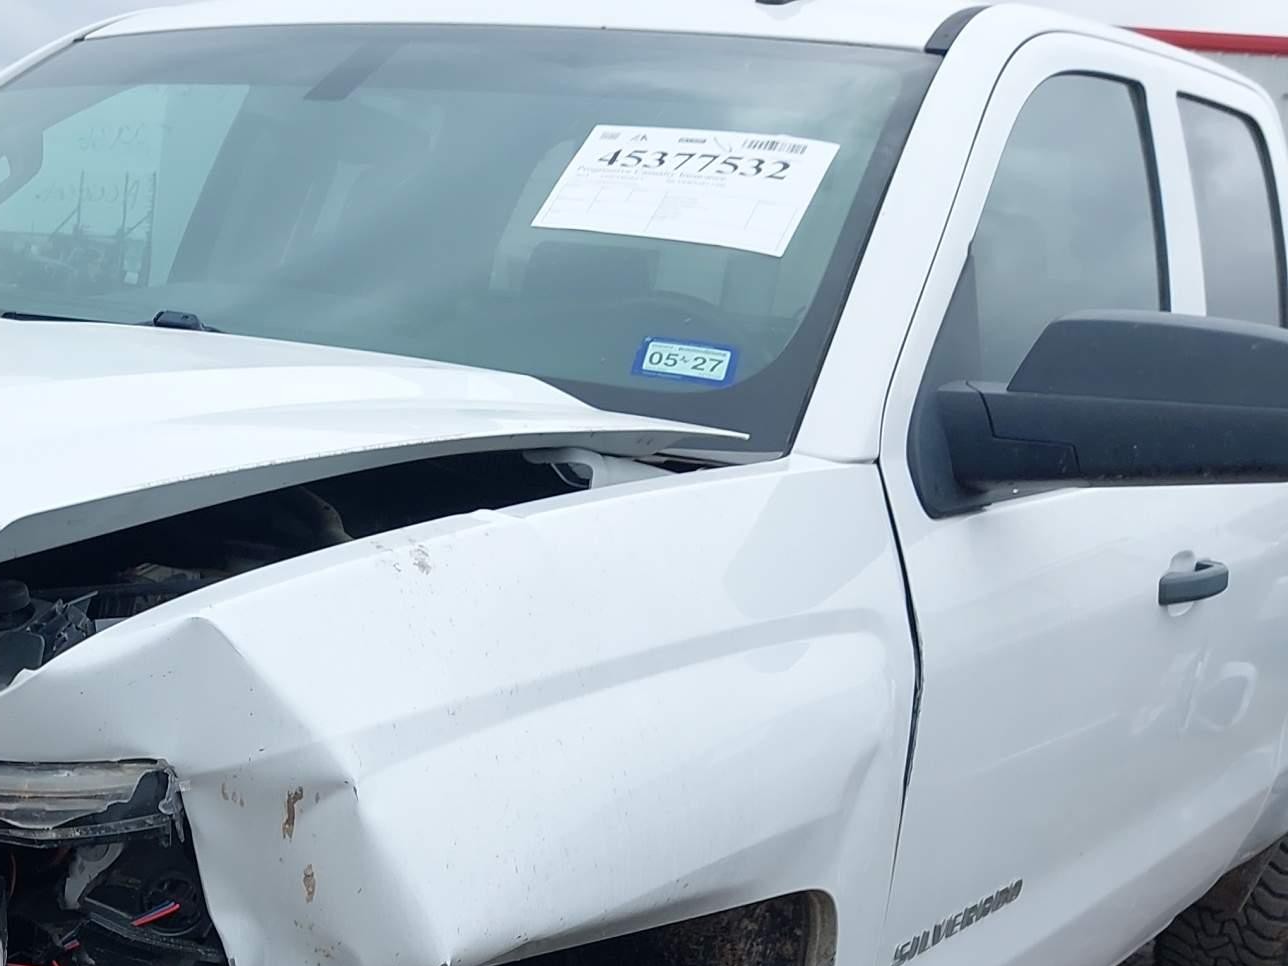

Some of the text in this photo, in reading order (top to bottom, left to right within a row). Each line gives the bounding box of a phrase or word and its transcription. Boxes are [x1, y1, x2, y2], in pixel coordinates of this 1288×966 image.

[598, 149, 791, 180] 45377532
[649, 351, 724, 373] 05 27
